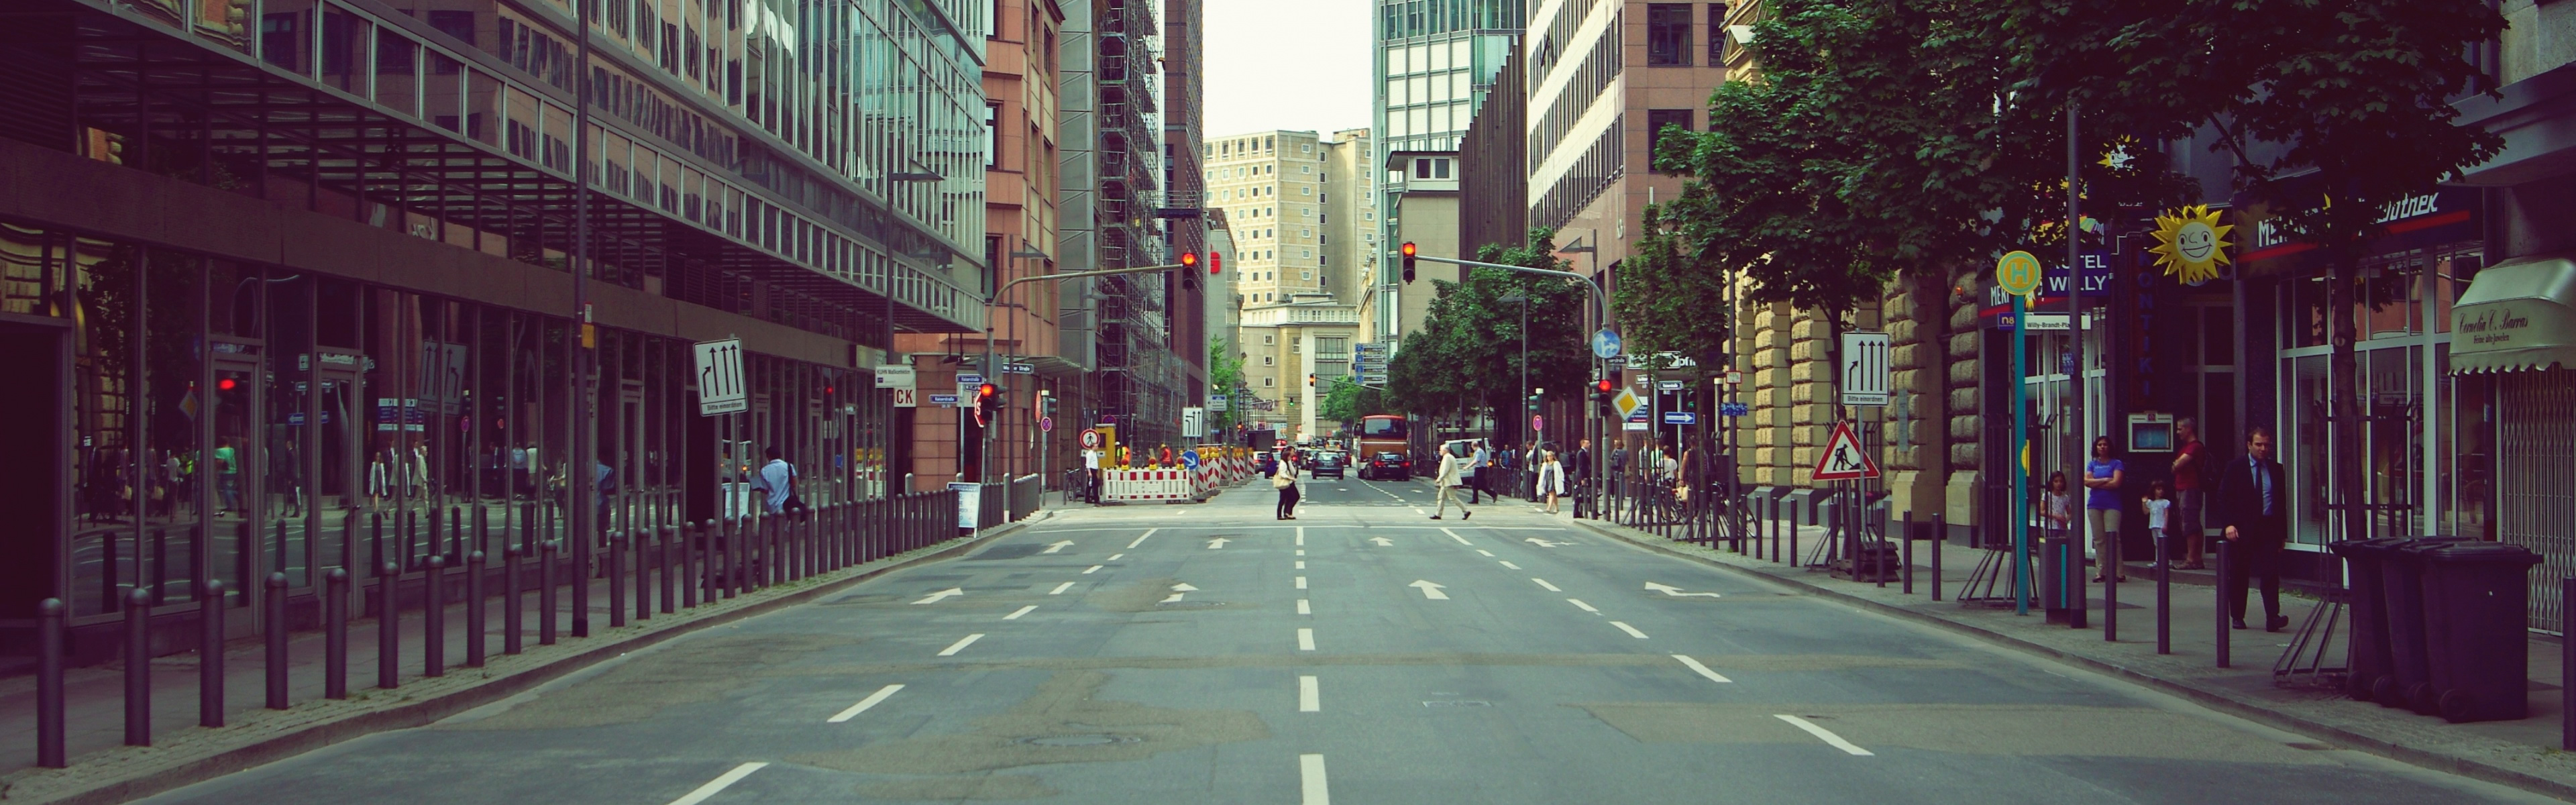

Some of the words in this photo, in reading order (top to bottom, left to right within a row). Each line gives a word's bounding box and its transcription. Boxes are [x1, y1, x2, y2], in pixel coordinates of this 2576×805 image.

[2010, 262, 2029, 284] H
[2049, 276, 2106, 292] WLY
[2002, 317, 2015, 325] n8
[2138, 251, 2153, 396] KONTIKI
[2500, 309, 2528, 329] Barras
[2473, 335, 2484, 343] Feine
